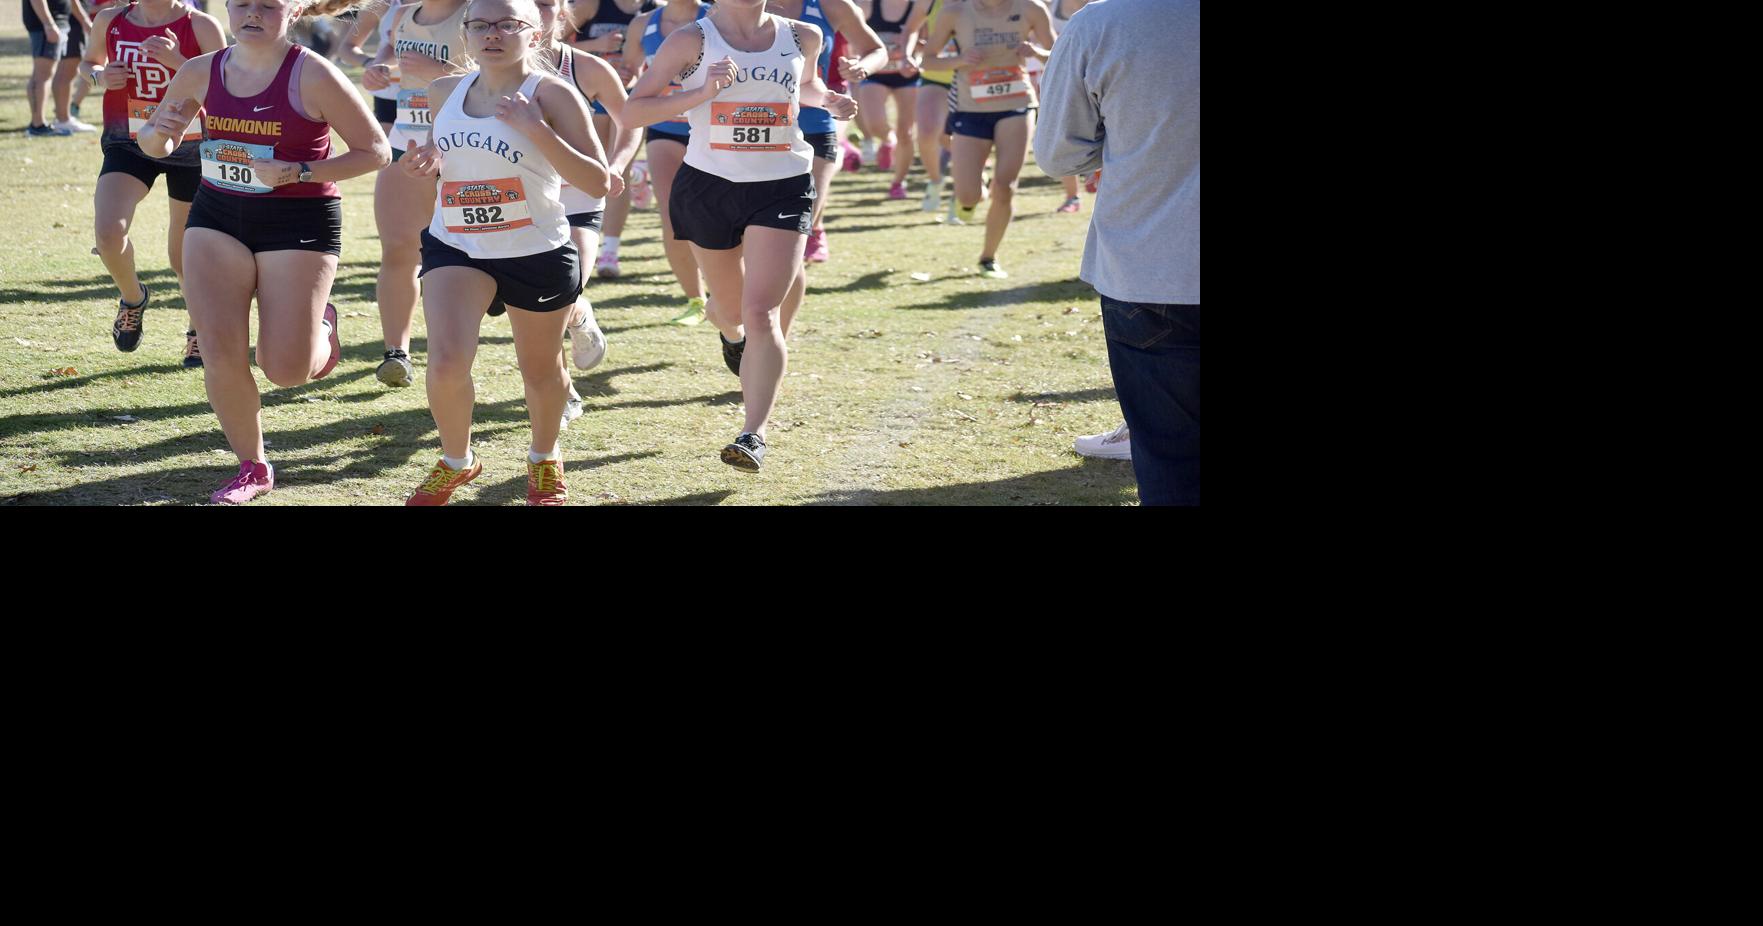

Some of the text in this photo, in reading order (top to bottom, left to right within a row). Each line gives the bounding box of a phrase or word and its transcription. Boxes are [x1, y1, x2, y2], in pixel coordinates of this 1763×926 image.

[722, 66, 797, 94] UGARS
[987, 83, 1011, 94] 497
[206, 115, 282, 136] ENOMONIE
[733, 127, 770, 143] 581
[437, 131, 523, 164] OUGARS
[218, 164, 252, 184] 130
[459, 194, 501, 205] COUNTRY
[464, 190, 491, 198] CROSS
[462, 206, 505, 225] 582
